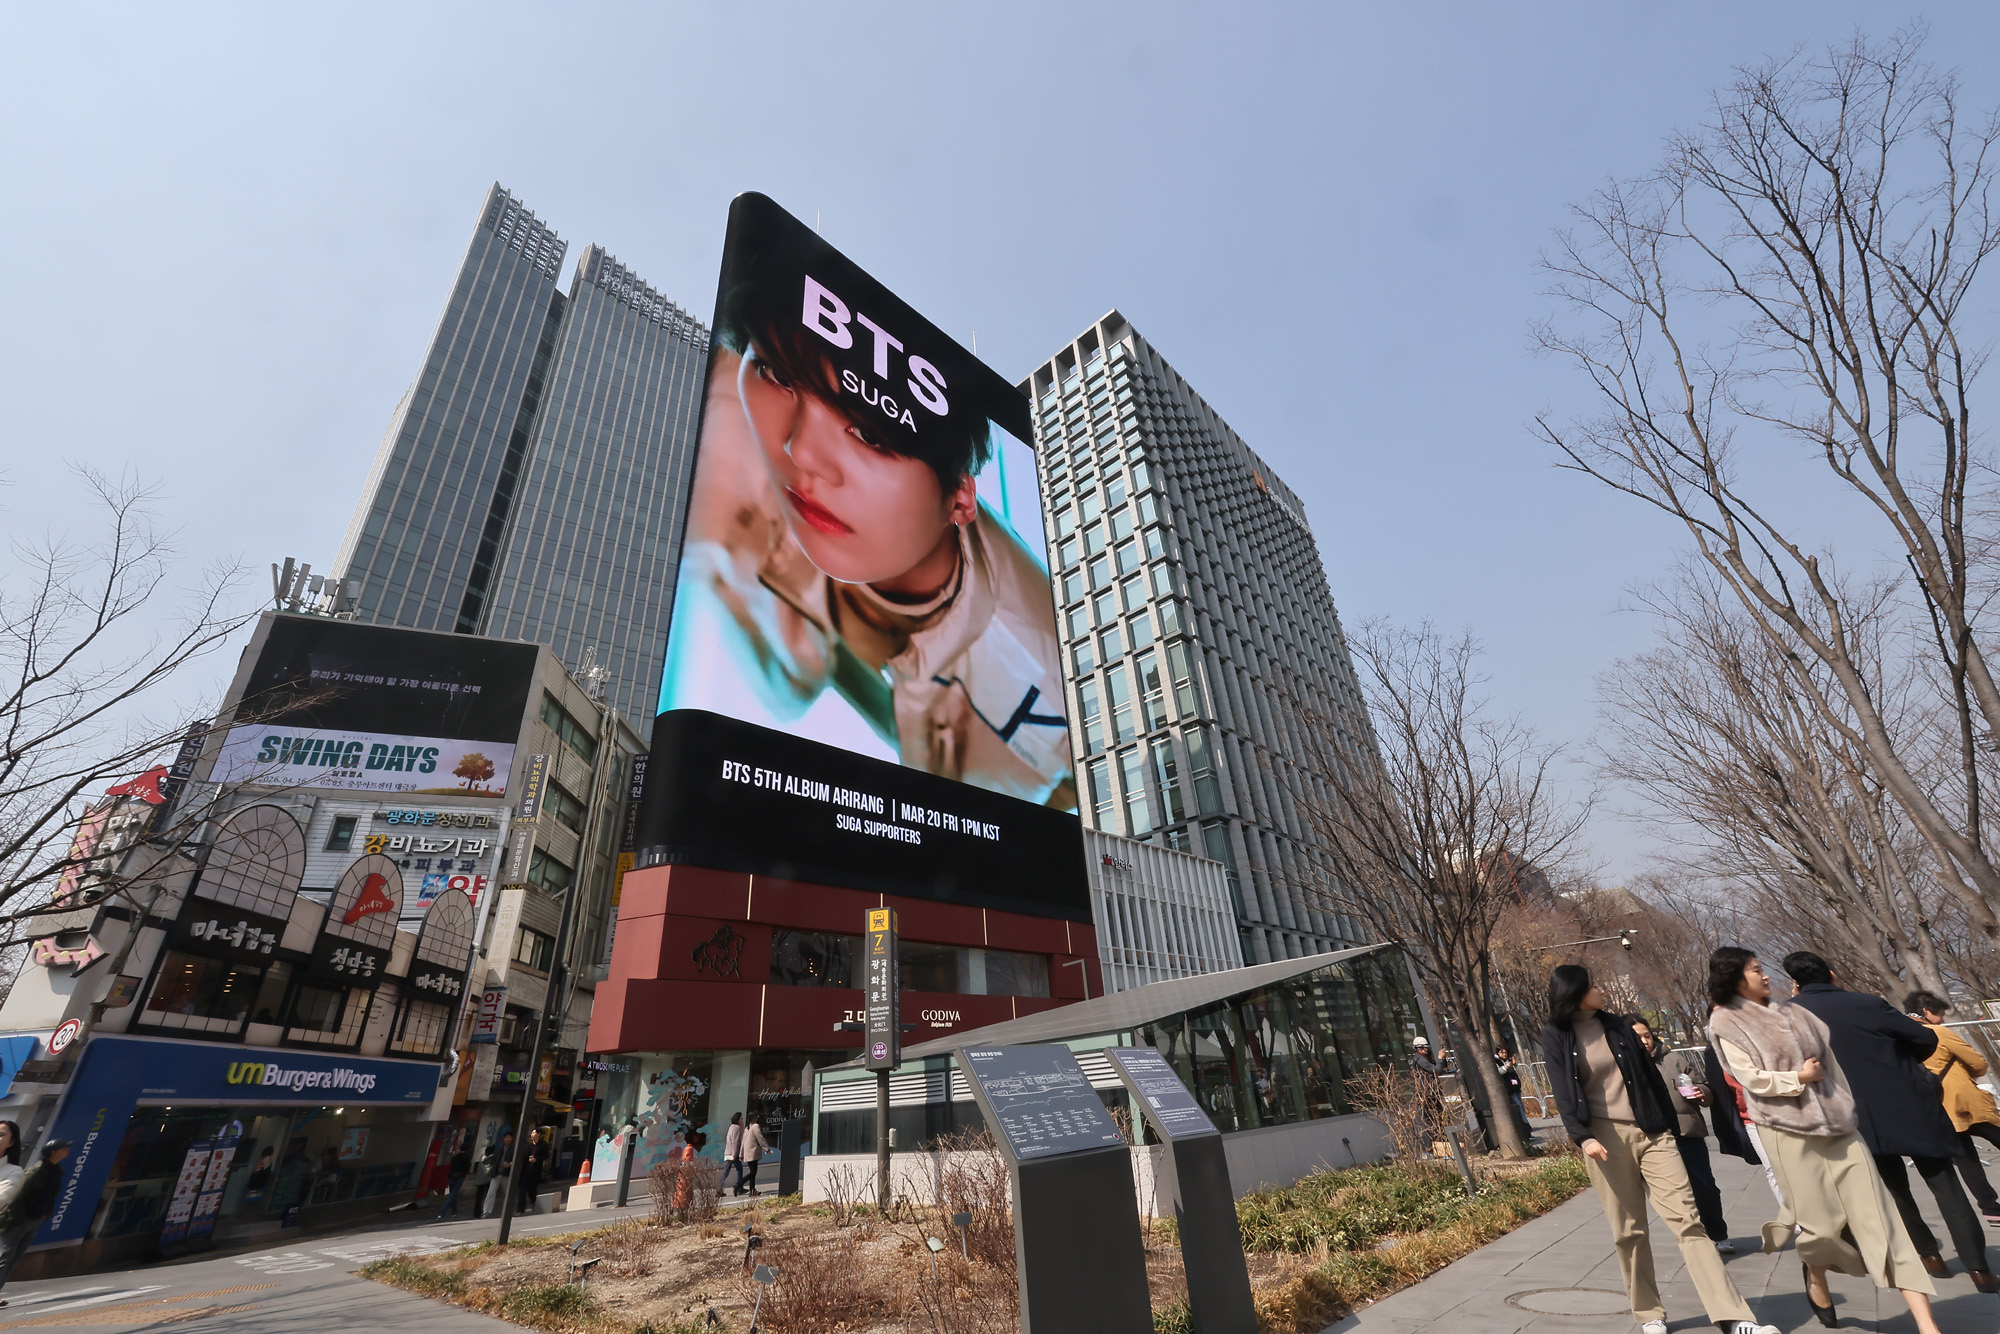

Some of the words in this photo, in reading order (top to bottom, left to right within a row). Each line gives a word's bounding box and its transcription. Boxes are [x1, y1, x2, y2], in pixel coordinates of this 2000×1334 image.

[802, 274, 949, 416] BTS
[842, 369, 917, 433] SUGA
[310, 669, 340, 681] 우리가
[344, 673, 384, 685] 기억해야
[400, 678, 419, 688] 가장
[422, 681, 460, 692] 아름다운
[462, 684, 482, 695] 선택
[257, 735, 364, 769] SWING
[365, 743, 440, 774] DAYS
[631, 762, 646, 798] 한의원
[722, 760, 750, 784] BTS
[754, 768, 781, 792] 5TH
[785, 775, 830, 803] ALBUM
[833, 787, 884, 815] ARIRANG
[901, 803, 925, 824] MAR
[927, 809, 940, 828] 20
[943, 813, 958, 832] FRI
[961, 818, 981, 837] 1PM
[983, 823, 1000, 842] KST
[836, 814, 862, 833] SUGA
[864, 818, 921, 845] SUPPORTERS
[364, 834, 490, 859] 강비뇨기과
[415, 858, 476, 873] 피부과
[190, 919, 276, 955] 마녀김밥
[875, 934, 883, 947] 7
[329, 948, 376, 977] 청담동
[415, 973, 461, 997] 마녀김밥
[871, 959, 880, 1002] 광화문
[479, 991, 502, 1033] 약국
[921, 1010, 961, 1021] GODIVA
[55, 1028, 73, 1046] 30
[758, 1087, 780, 1101] Happy
